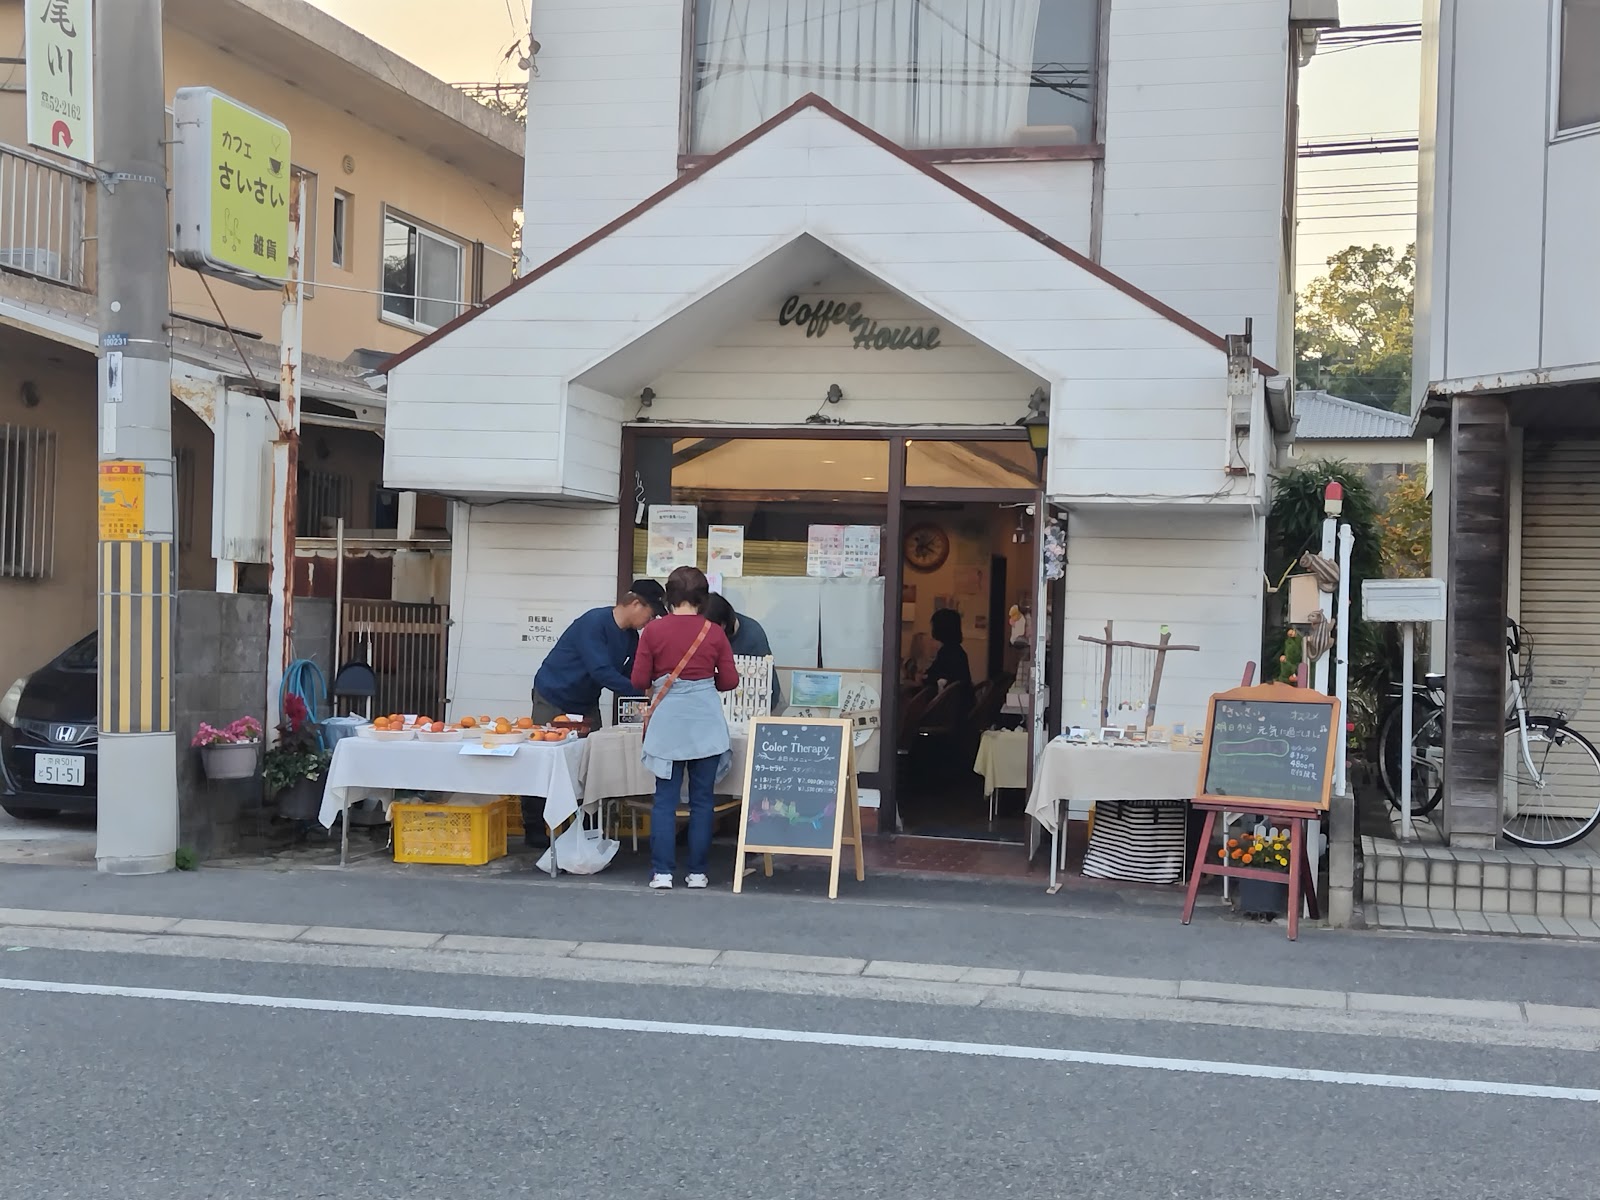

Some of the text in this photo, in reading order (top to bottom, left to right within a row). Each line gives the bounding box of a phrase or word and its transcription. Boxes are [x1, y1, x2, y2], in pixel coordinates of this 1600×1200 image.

[222, 131, 252, 159] カフェ
[218, 162, 284, 208] さいさい
[779, 295, 941, 350] Coffee House
[762, 741, 830, 755] Color Therapy
[46, 766, 80, 783] 51-51
[755, 764, 787, 772] カラーセラピー
